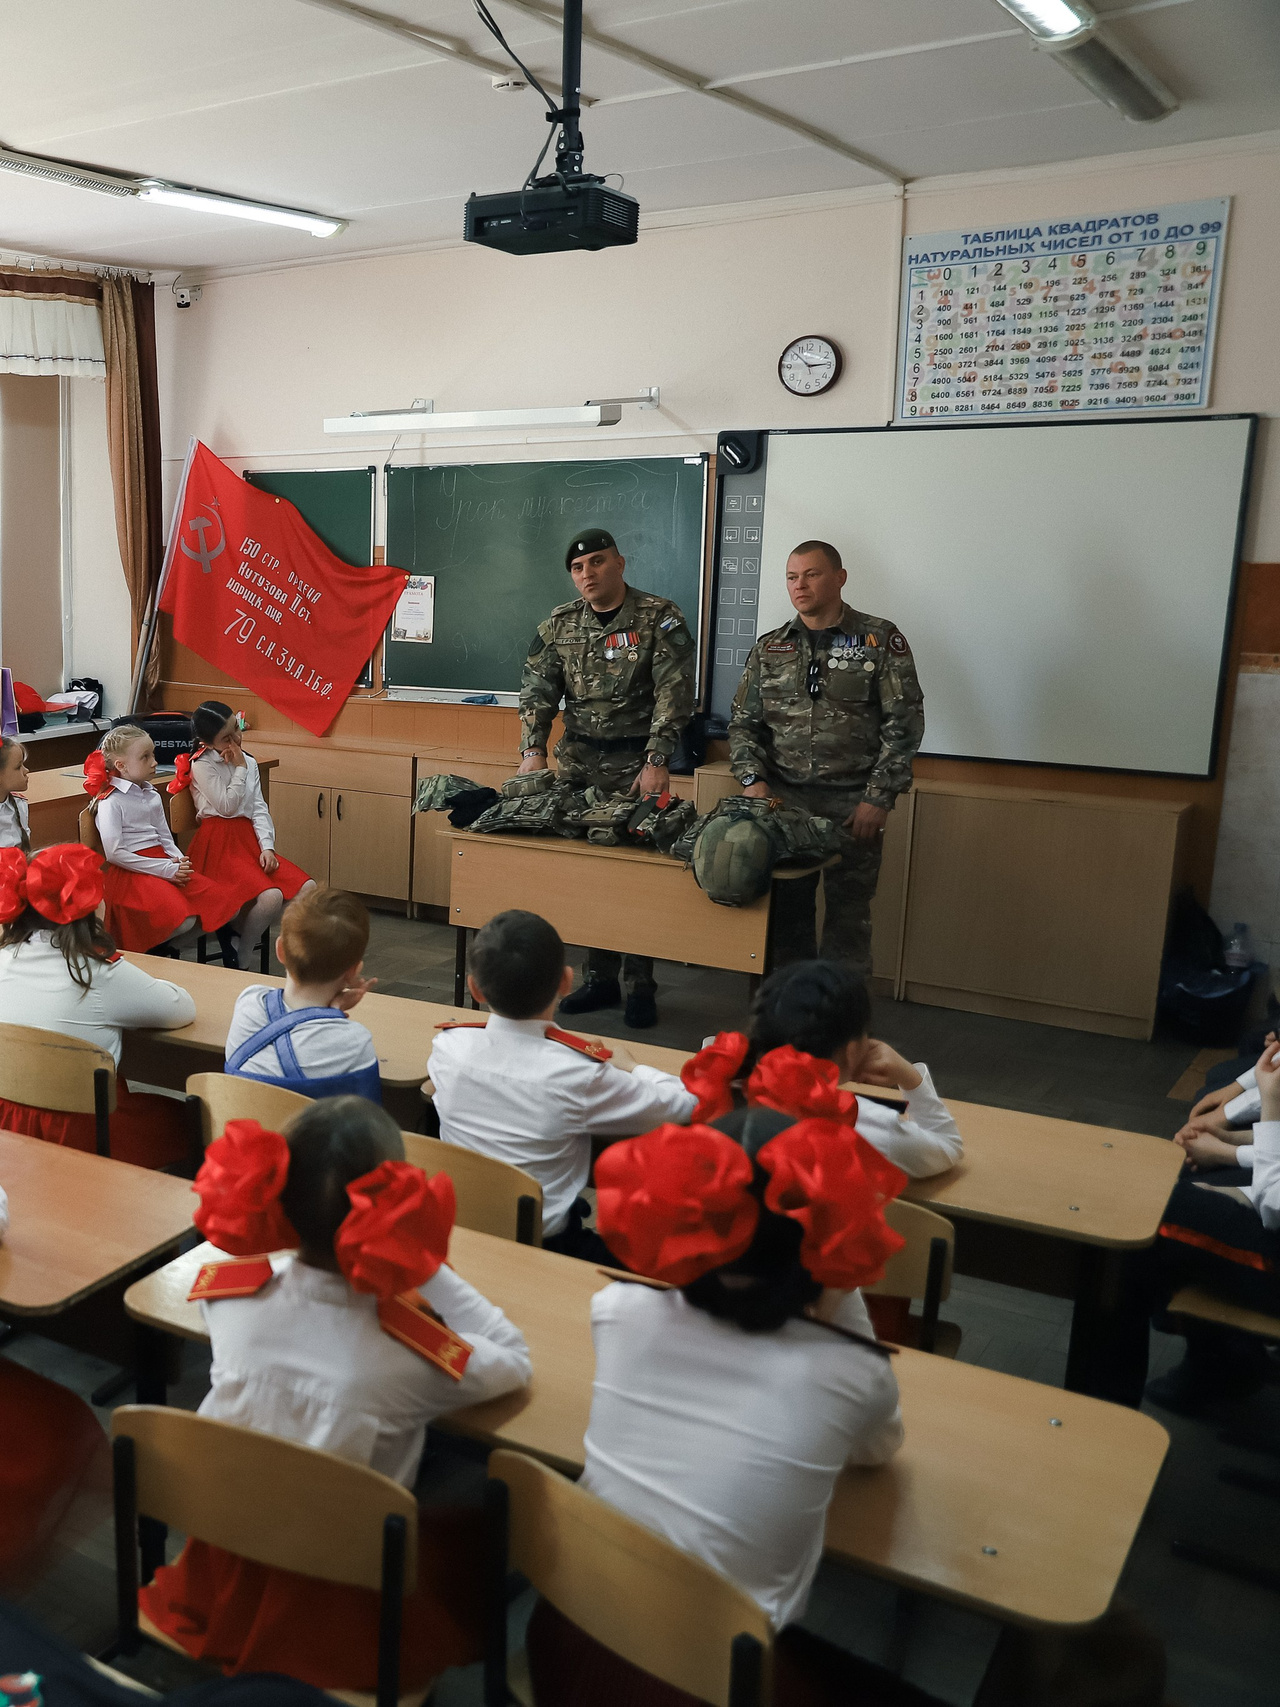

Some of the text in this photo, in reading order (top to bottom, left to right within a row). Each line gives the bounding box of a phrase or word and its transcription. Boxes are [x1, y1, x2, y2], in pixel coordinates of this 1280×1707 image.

[961, 213, 1159, 245] ТАБЛИЦА КВАДРАТОВ
[908, 222, 1221, 265] НАТУРАЛЬНЫХ ЧИСЕЛ ОТ 10 ДО 99
[943, 241, 1206, 280] 0 1 2 3 4 5 6 7 8 9
[919, 291, 924, 300] 1
[1160, 268, 1176, 276] 324
[916, 320, 923, 329] 3
[1186, 298, 1206, 306] 1521
[917, 305, 923, 315] 2
[915, 334, 921, 343] 4
[1122, 319, 1143, 327] 2209
[1152, 316, 1173, 324] 2304
[1182, 314, 1204, 322] 2401
[791, 353, 798, 361] 10
[806, 343, 814, 351] 12
[824, 351, 829, 359] 2
[914, 349, 921, 359] 5
[1121, 334, 1142, 342] 3249
[914, 364, 920, 373] 6
[1091, 351, 1112, 359] 4356
[910, 392, 917, 402] 8
[1008, 387, 1027, 395] 6889
[1117, 381, 1138, 389] 7569
[1176, 377, 1198, 385] 7921
[912, 378, 918, 387] 7
[1062, 369, 1083, 377] 5625
[910, 405, 916, 415] 9
[1007, 401, 1026, 409] 8649
[1116, 396, 1137, 404] 9409
[1174, 393, 1195, 401] 9801
[435, 472, 506, 558] Урок
[239, 536, 261, 559] 150
[261, 552, 280, 574] СТР.
[226, 577, 282, 626] ИДРИЦК. ДИВ.
[298, 606, 312, 624] СТ.
[224, 608, 257, 644] 79
